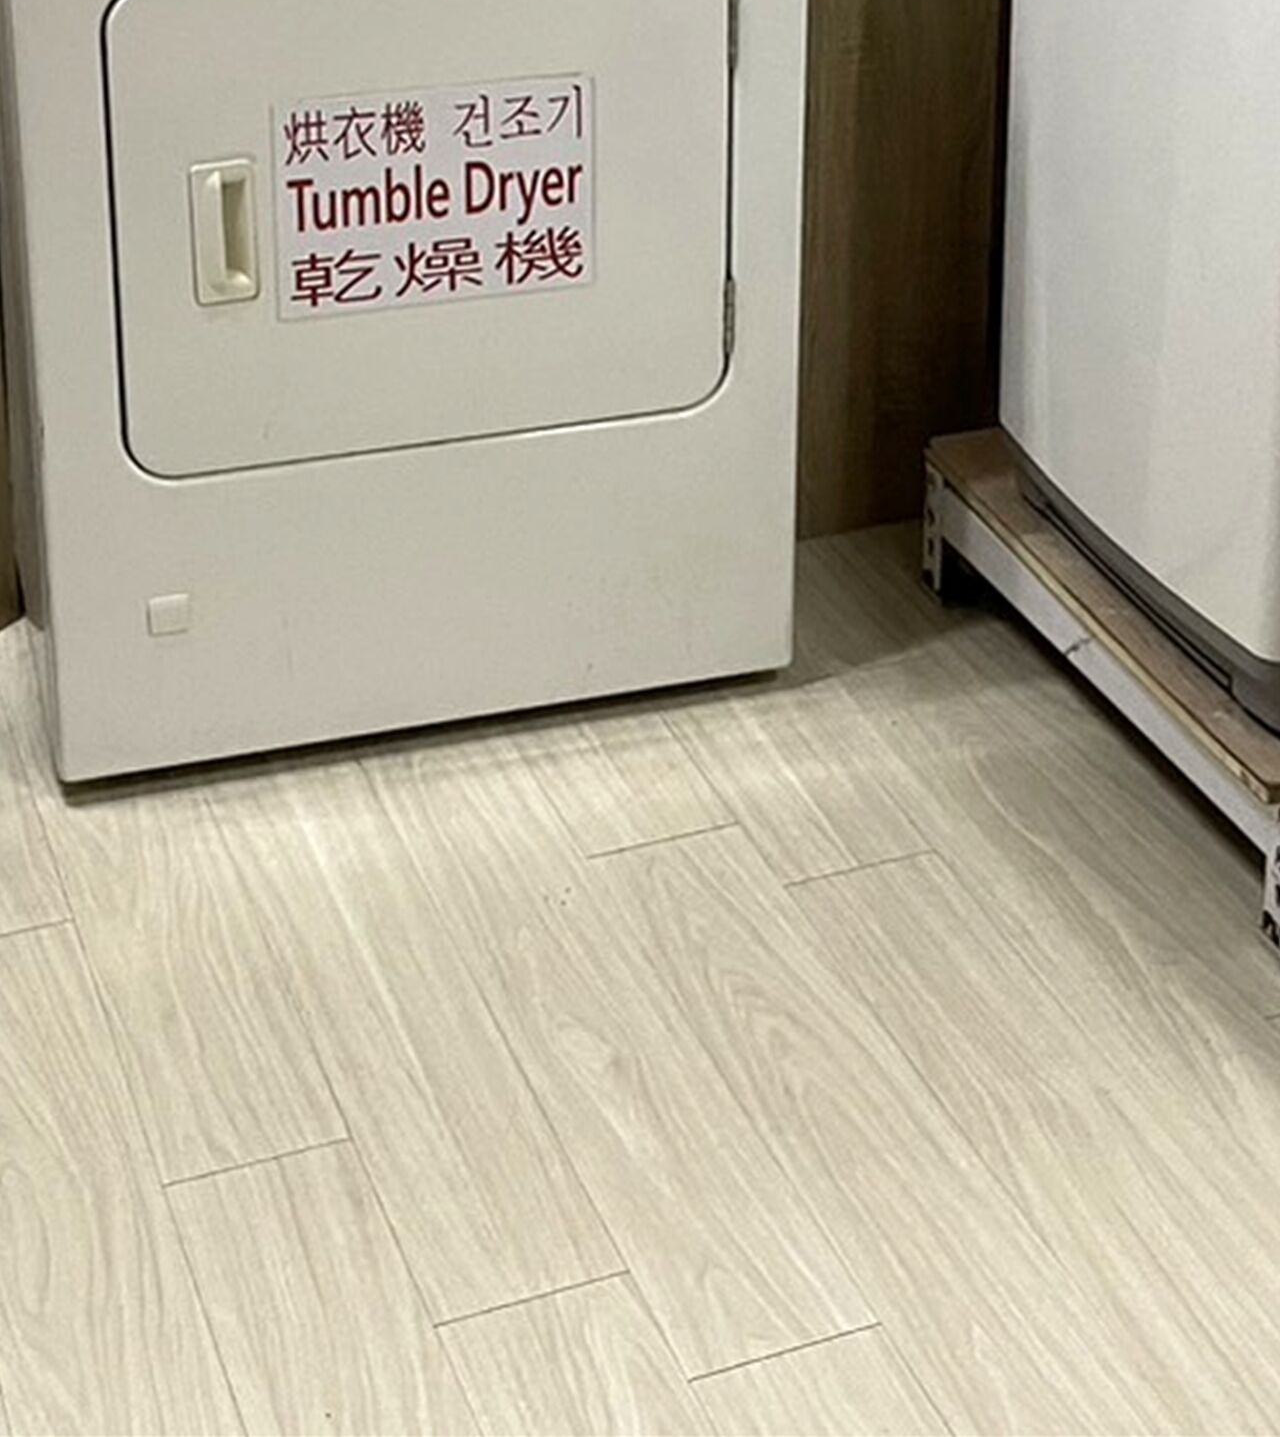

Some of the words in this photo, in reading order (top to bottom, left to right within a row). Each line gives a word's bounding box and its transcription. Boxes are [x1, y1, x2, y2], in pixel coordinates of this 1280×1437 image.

[284, 100, 426, 166] 烘衣機
[453, 84, 584, 149] 건조기
[286, 163, 450, 233] Tumble
[465, 160, 583, 226] Dryer
[290, 225, 584, 308] 乾燥機
